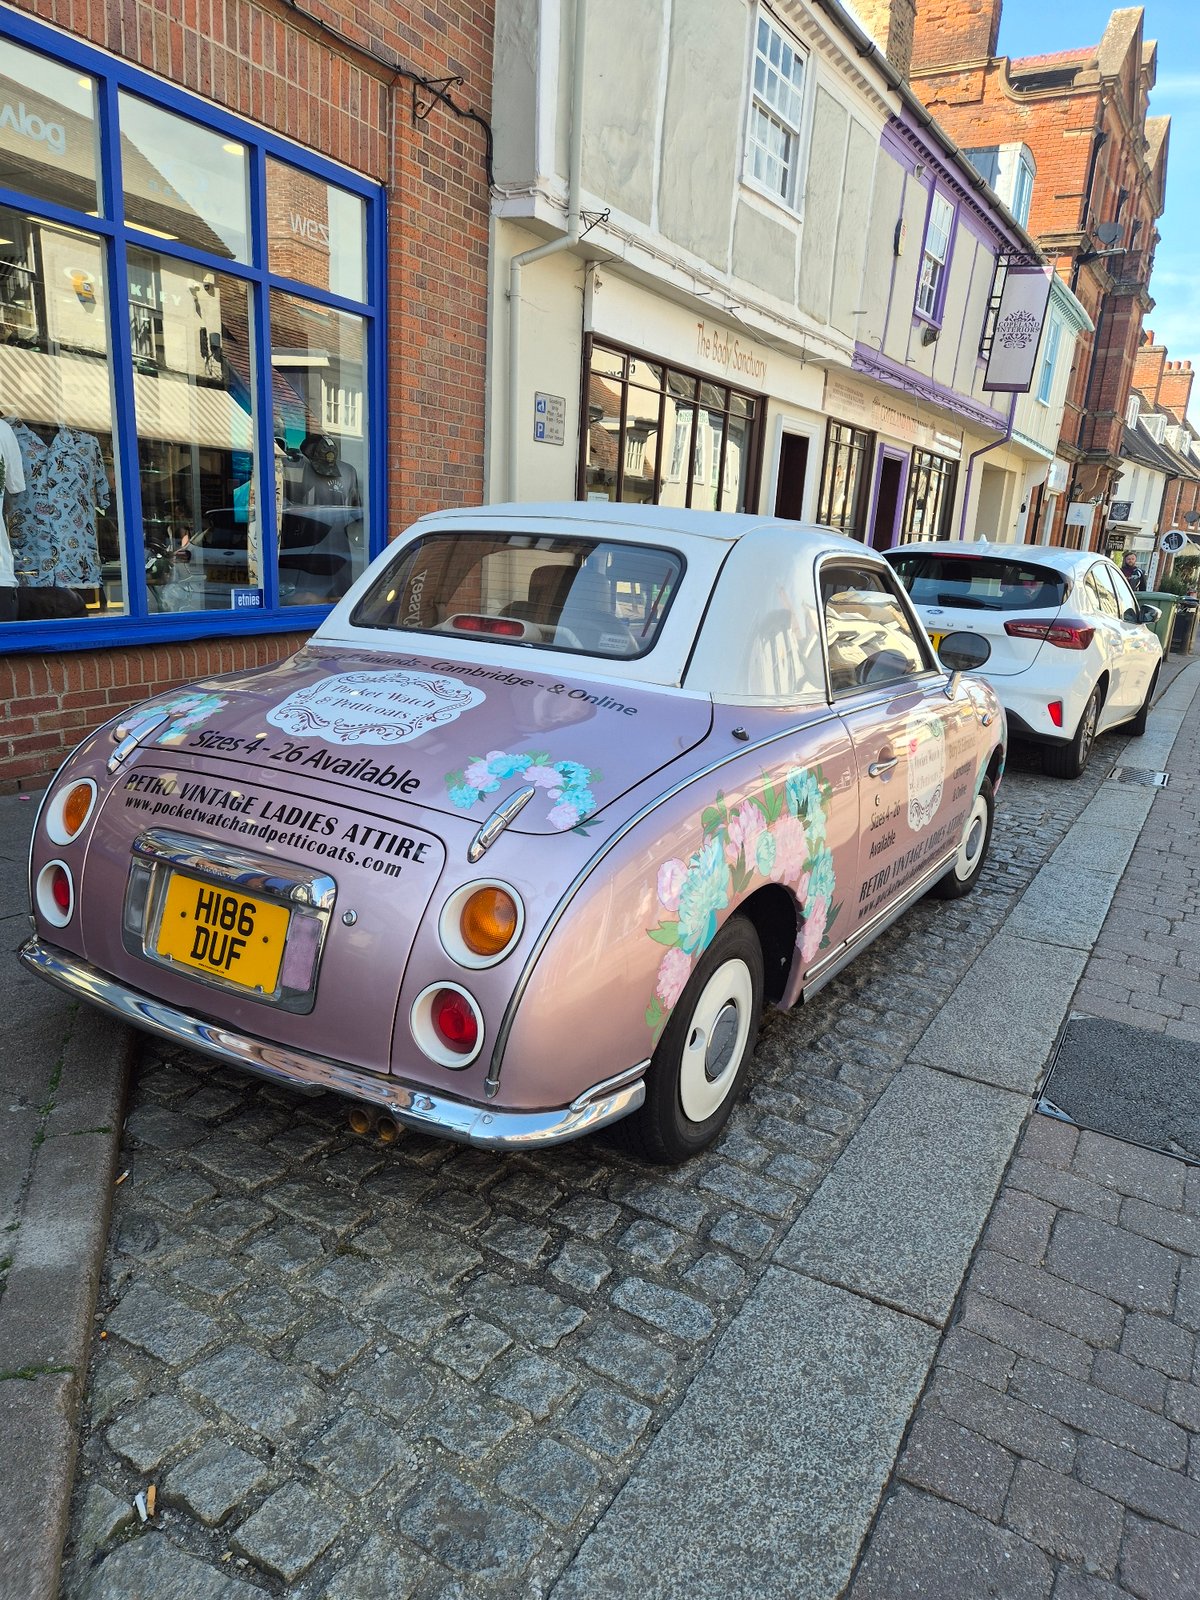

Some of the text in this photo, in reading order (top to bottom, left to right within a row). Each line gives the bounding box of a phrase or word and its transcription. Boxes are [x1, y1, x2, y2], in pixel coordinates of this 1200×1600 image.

[697, 321, 768, 387] The Body Sanctuary
[237, 593, 260, 606] etnies
[331, 698, 409, 719] Petticoats
[388, 692, 436, 708] Watch
[431, 660, 534, 688] Cambridge
[547, 683, 565, 696] &
[567, 688, 638, 716] Online
[189, 730, 245, 751] Sizes
[243, 738, 266, 754] 4
[268, 742, 310, 762] 26
[301, 748, 421, 794] Available
[124, 774, 432, 864] RETRO VINTAGE LADIES ATTIRE
[125, 796, 403, 878] www.pocketwatchandpetticoats.com
[869, 829, 896, 859] Available
[859, 865, 891, 903] RETRO
[194, 888, 256, 937] H186
[190, 925, 246, 970] DUF
